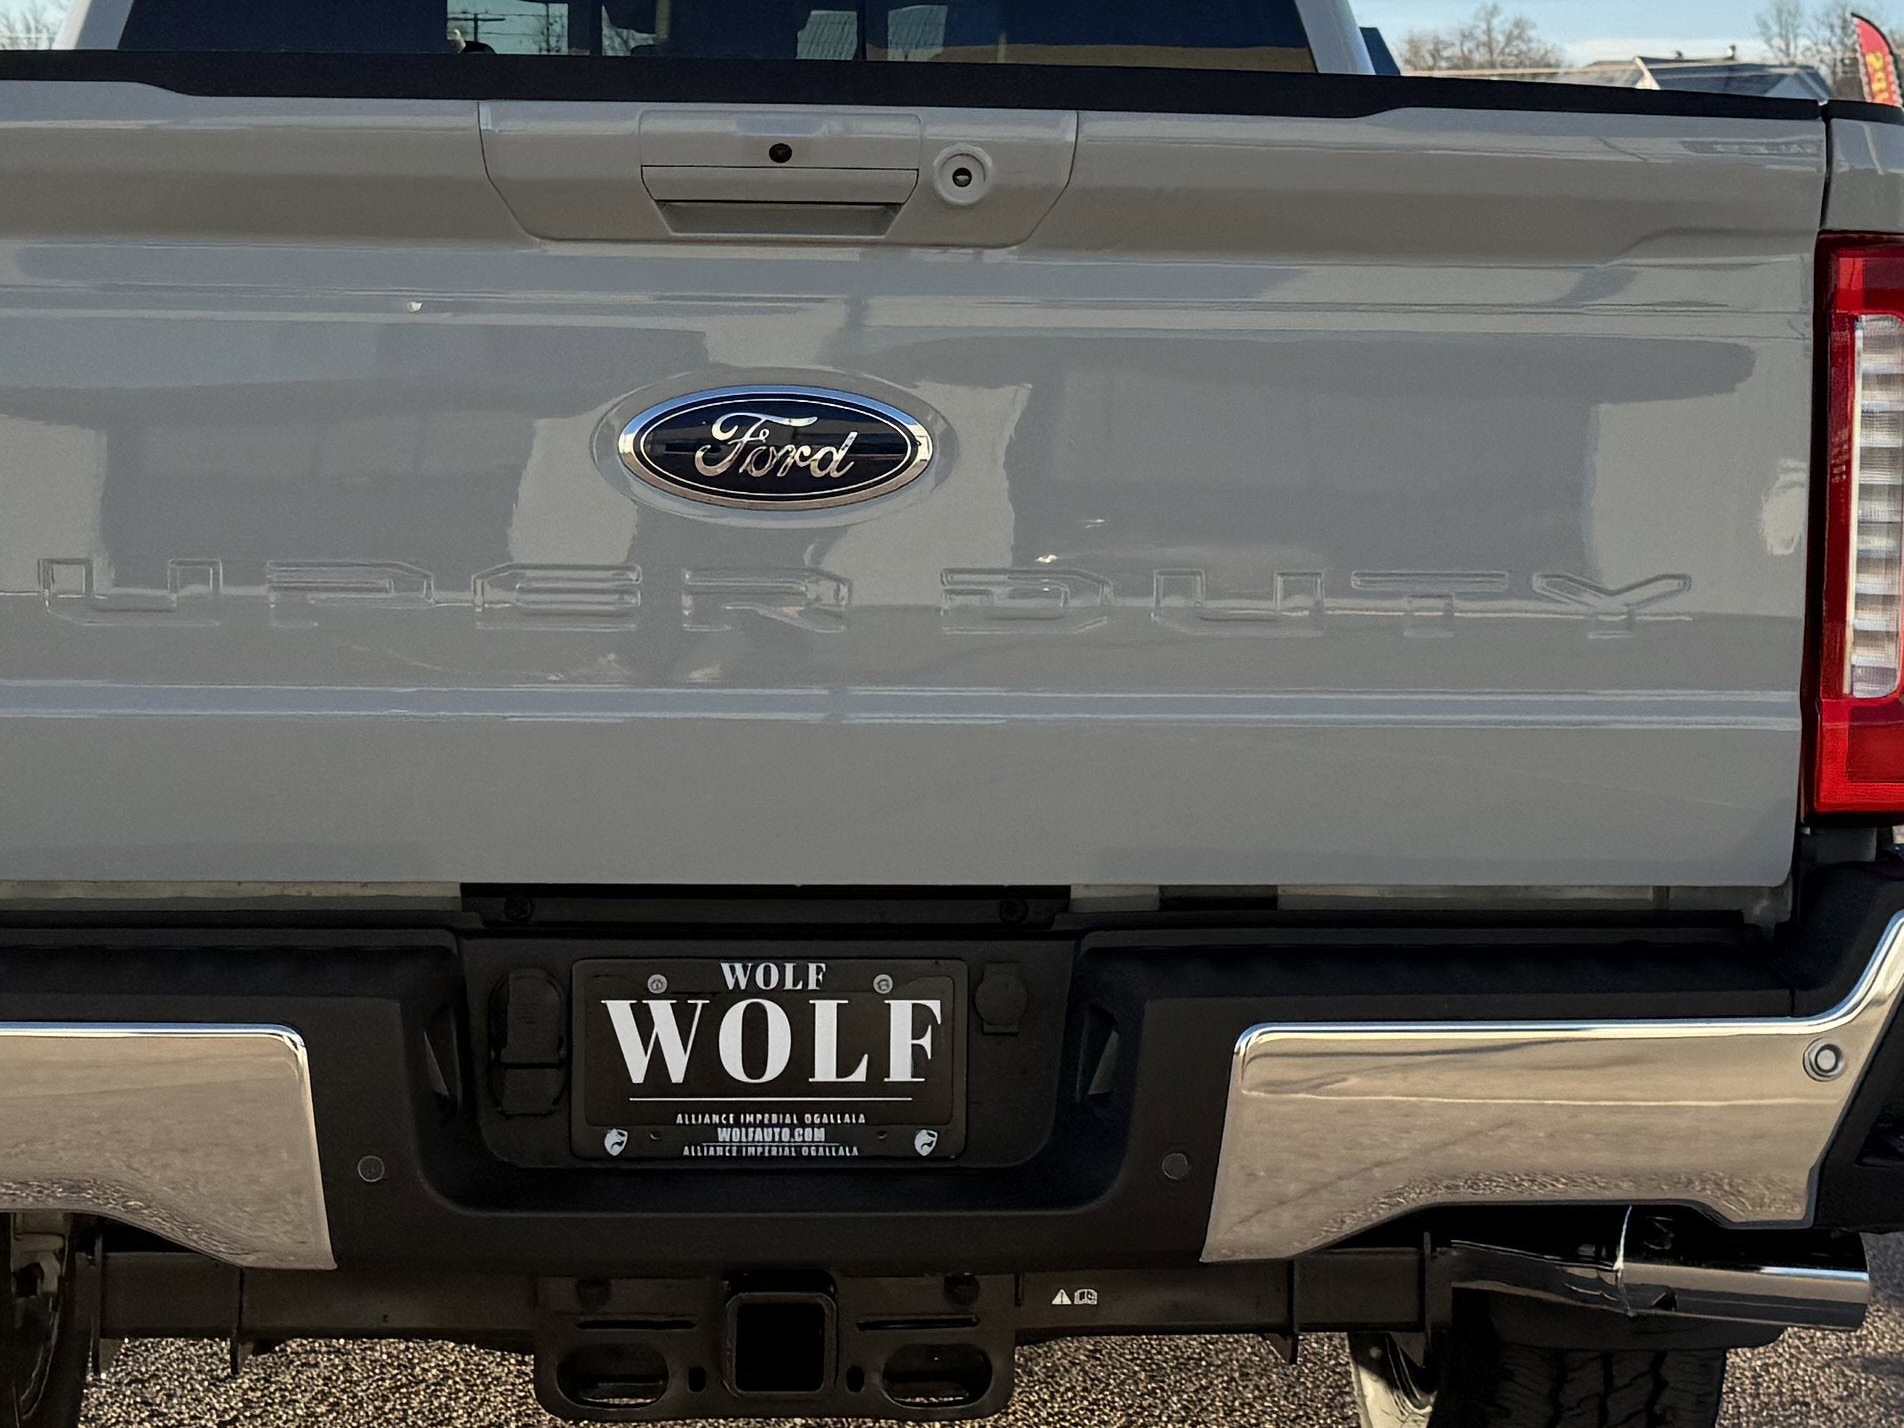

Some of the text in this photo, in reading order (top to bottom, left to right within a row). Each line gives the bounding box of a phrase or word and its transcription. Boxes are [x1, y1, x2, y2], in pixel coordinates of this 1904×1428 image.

[695, 412, 858, 478] Ford
[941, 567, 1692, 639] DUTY
[720, 962, 827, 991] WOLF
[600, 998, 942, 1084] WOLF
[675, 1113, 866, 1125] ALLIANCE IMPERIAL OGALLALA
[717, 1127, 826, 1142] WOLFAUTO.COM
[682, 1146, 859, 1157] ALLIANCE IMPERIAL OGALLALA
